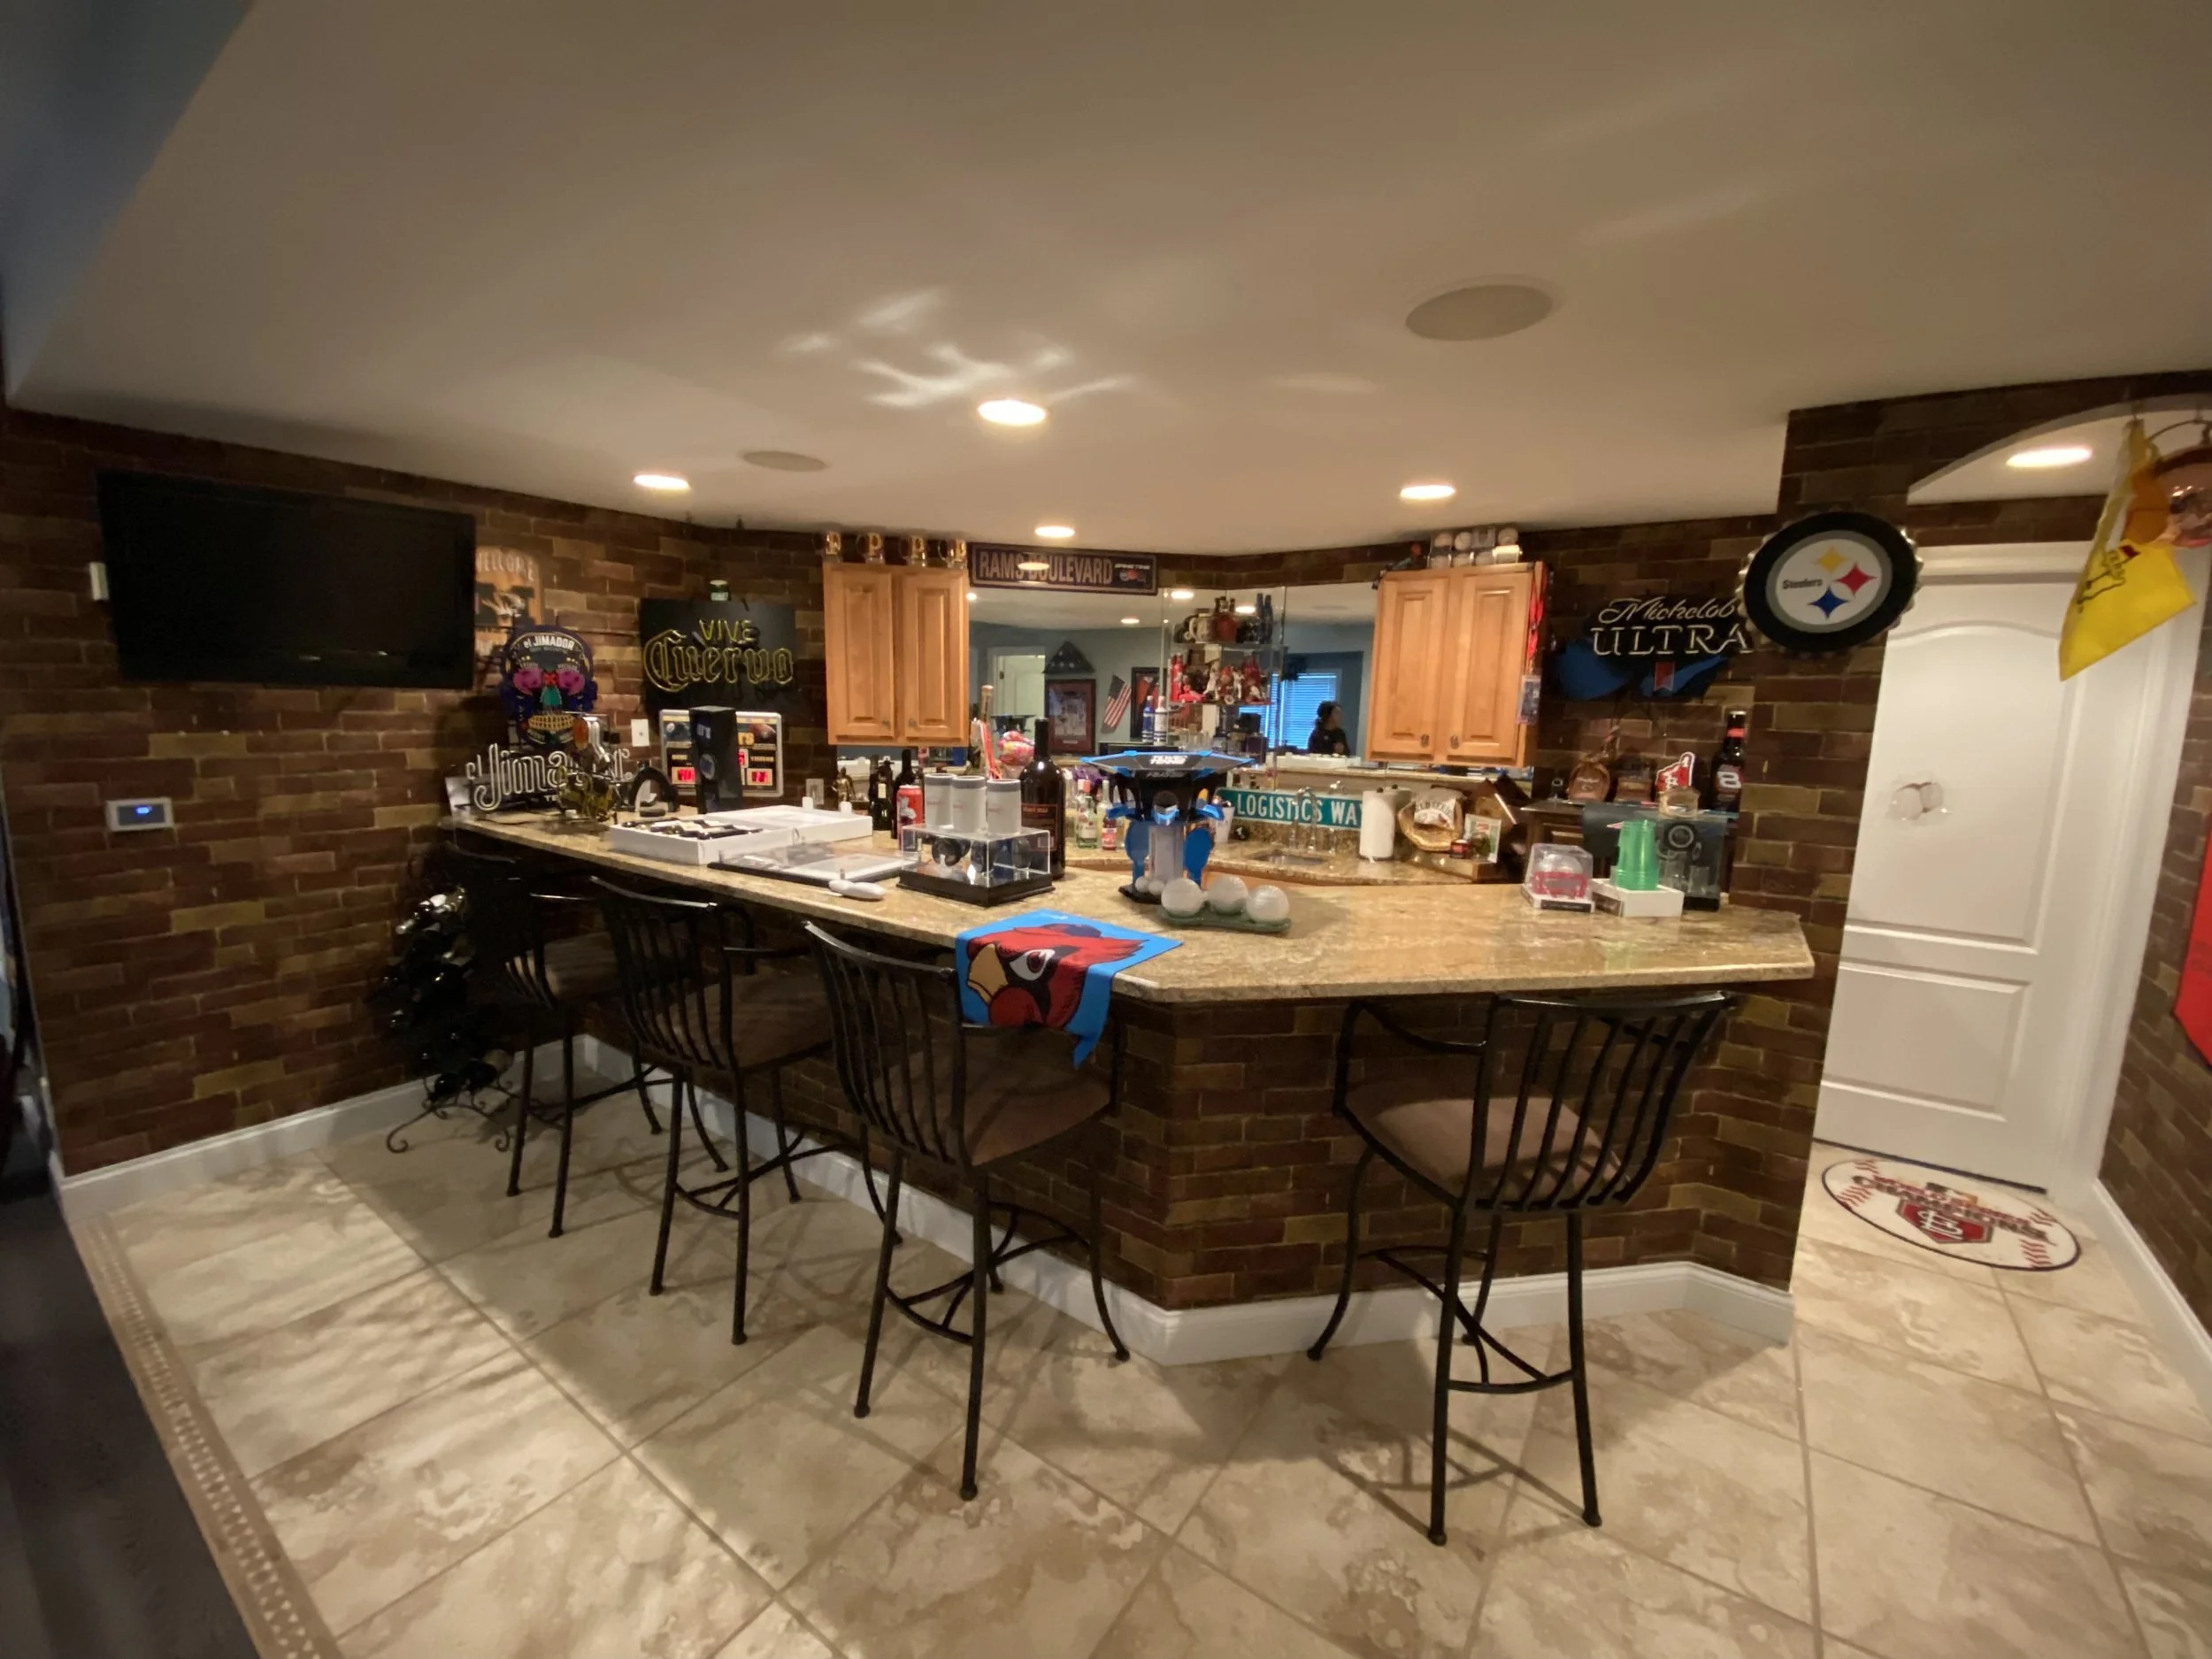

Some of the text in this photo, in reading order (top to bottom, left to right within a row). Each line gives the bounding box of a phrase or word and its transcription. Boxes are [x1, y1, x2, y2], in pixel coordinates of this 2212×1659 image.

[979, 552, 1112, 584] RAMS BOULEVARD
[1783, 578, 1824, 590] Steelers
[1598, 595, 1738, 624] Michelob
[534, 635, 575, 650] JIMADOR
[699, 619, 755, 641] VIVE
[1590, 623, 1755, 656] ULTRA
[643, 629, 794, 693] Cuervo
[1717, 771, 1741, 788] 8
[1237, 794, 1363, 826] LOGISTICS WA
